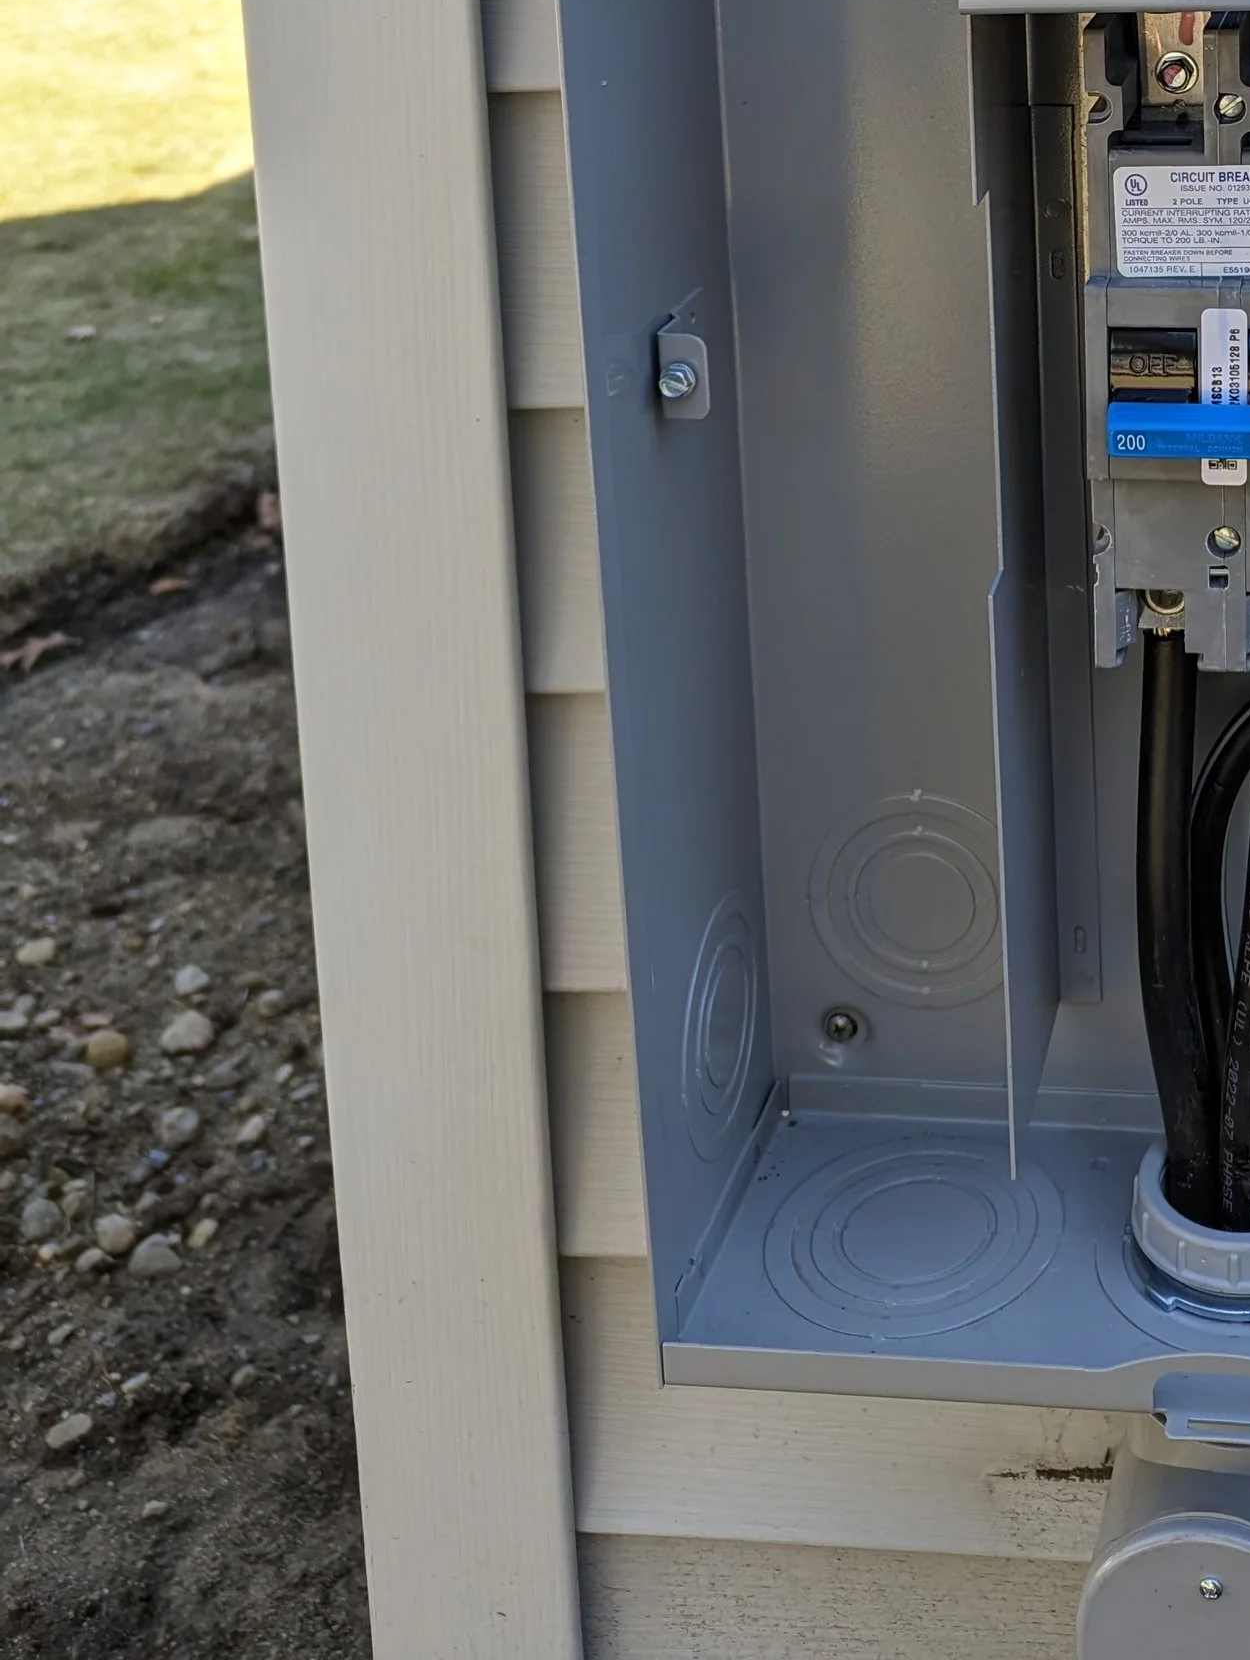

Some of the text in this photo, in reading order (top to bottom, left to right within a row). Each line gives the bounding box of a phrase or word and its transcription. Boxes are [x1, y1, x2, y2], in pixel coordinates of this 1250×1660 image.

[1170, 172, 1215, 183] CIRCUIT
[1125, 199, 1149, 207] LISTED
[1172, 198, 1178, 206] 2
[1121, 209, 1164, 217] CURRENT
[1166, 209, 1231, 217] INTERRUPTING
[1129, 265, 1196, 273] 1047135 REV. E
[1229, 328, 1240, 342] P6
[1129, 354, 1177, 375] OFF
[1117, 434, 1146, 451] 200
[1223, 1148, 1235, 1213] PHASE
